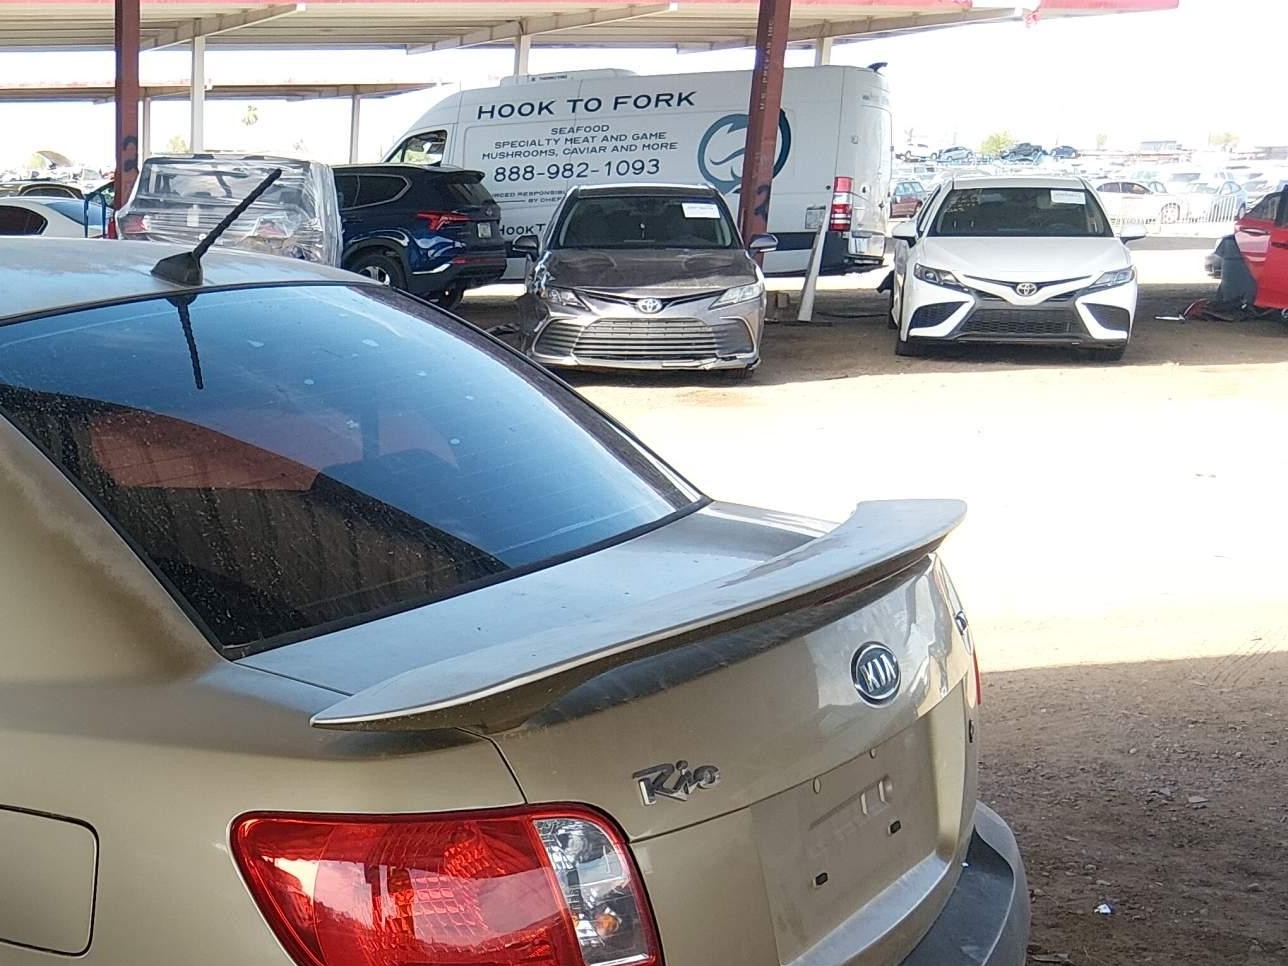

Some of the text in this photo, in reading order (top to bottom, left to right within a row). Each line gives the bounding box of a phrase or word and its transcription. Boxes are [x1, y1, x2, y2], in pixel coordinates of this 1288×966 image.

[477, 91, 697, 120] HOOK TO FORK
[494, 131, 667, 150] SPECIALTY MEAT AND GAME
[551, 124, 610, 136] SEAFOOD
[482, 141, 678, 161] MUSHROOMS, CAVIAR AND MORE
[493, 158, 661, 183] 888-982-1093
[860, 654, 897, 691] KIA
[632, 760, 721, 806] Rio
